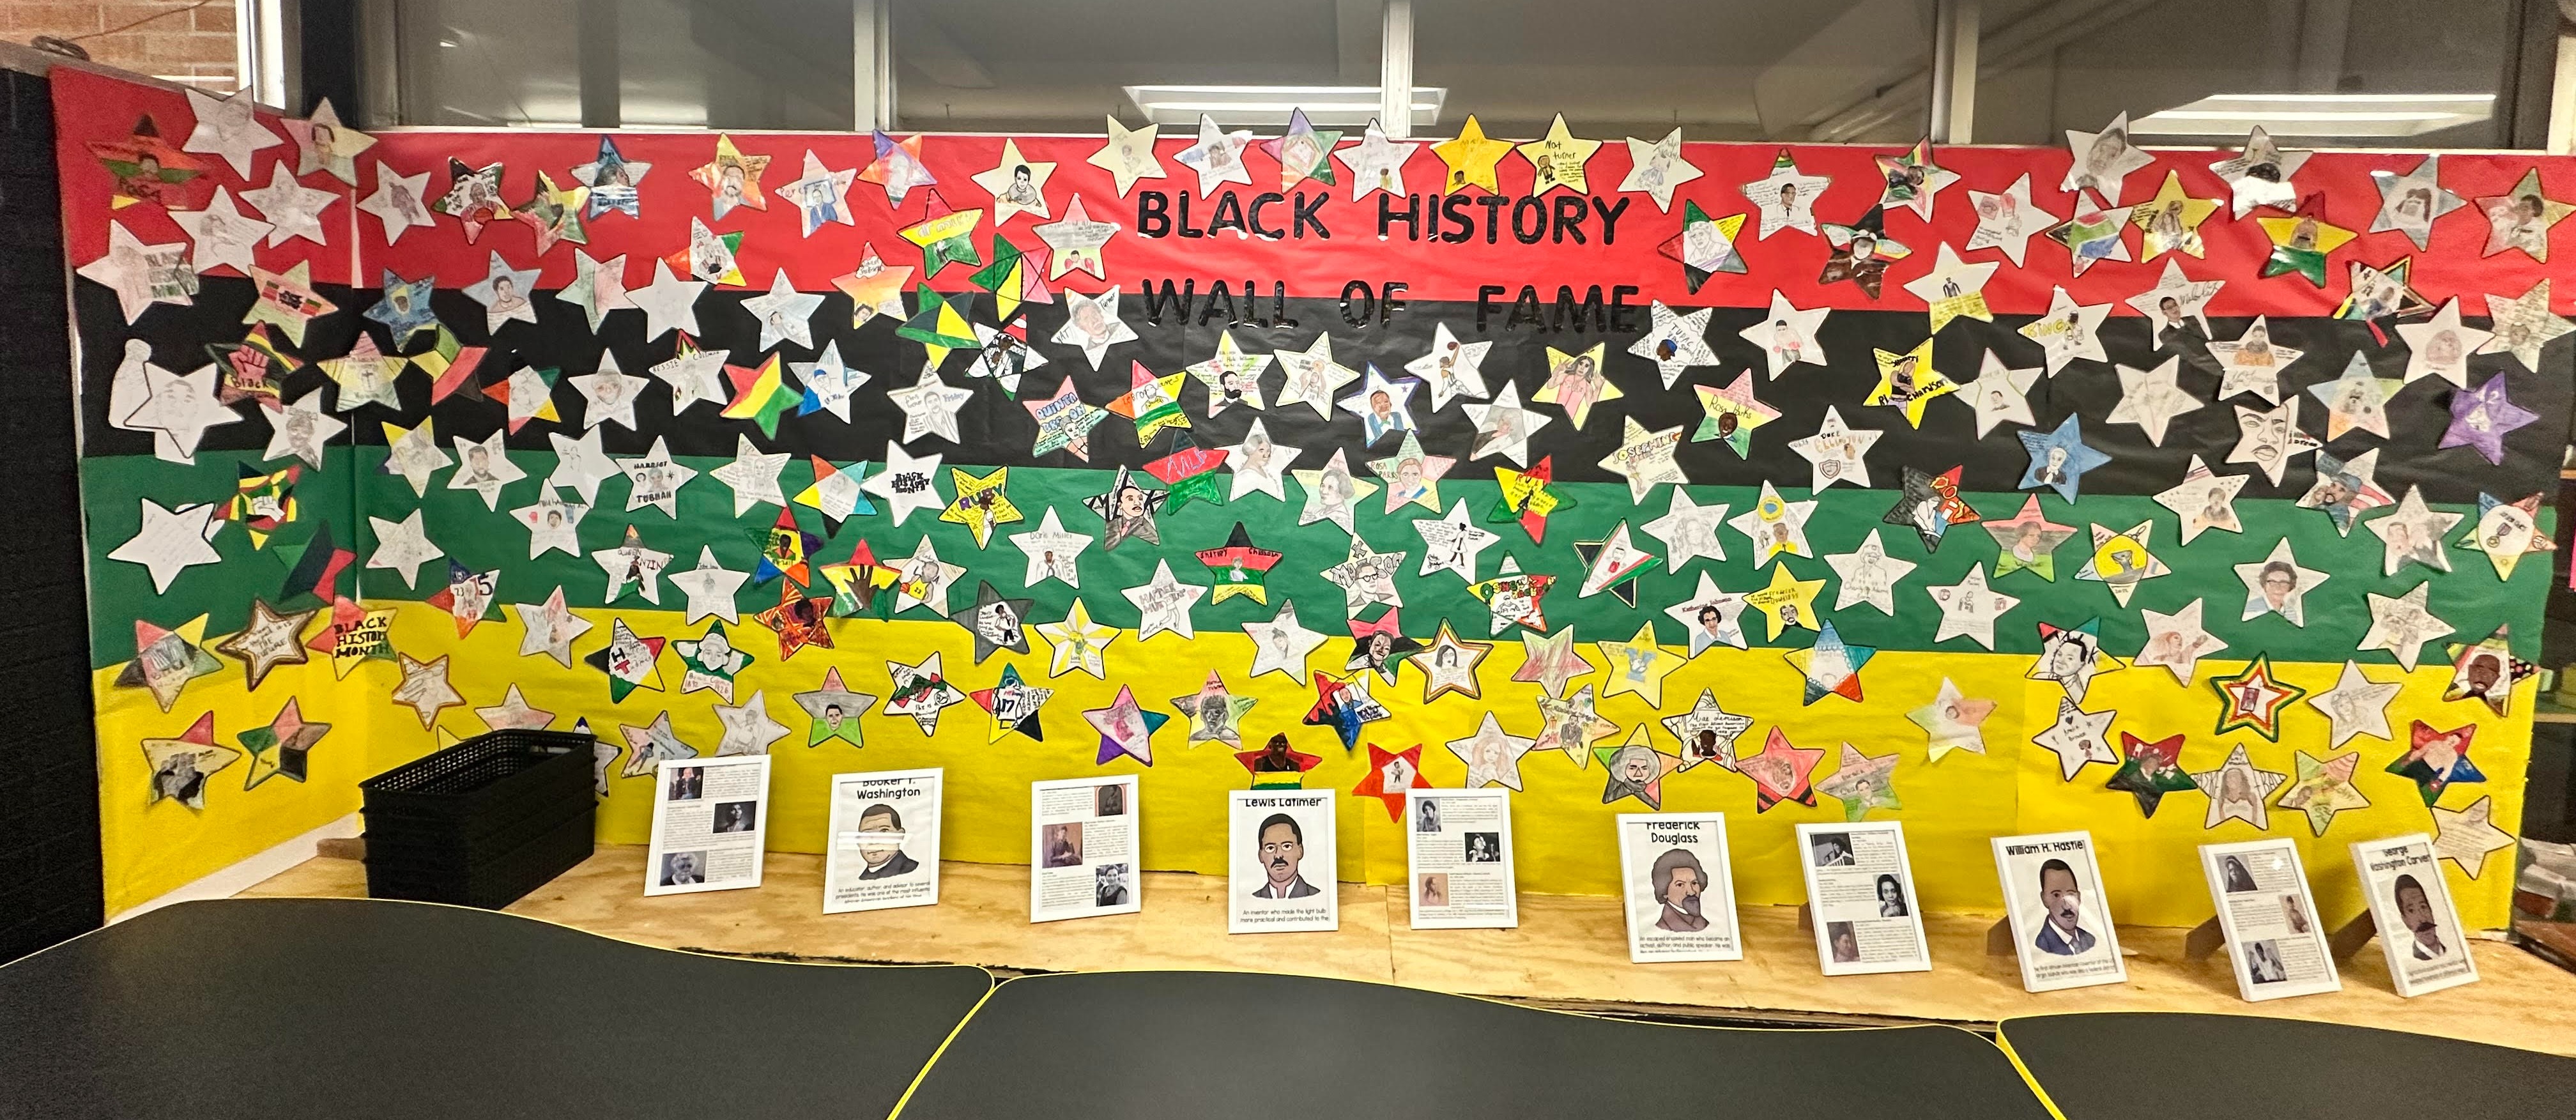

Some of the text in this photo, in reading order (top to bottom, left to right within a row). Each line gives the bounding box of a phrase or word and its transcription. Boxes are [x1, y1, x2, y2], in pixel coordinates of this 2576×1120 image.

[1545, 140, 1562, 150] Nat
[1552, 151, 1577, 160] turner
[1137, 190, 1630, 245] BLACK HISTORY
[1142, 279, 1639, 334] WALL OF FAME
[1035, 392, 1079, 421] QUINTA
[334, 617, 387, 635] BLACK
[857, 788, 921, 800] Washington
[1245, 798, 1322, 808] Lewis Latimer
[1646, 822, 1701, 831] Frederick
[1651, 832, 1699, 846] Douglass
